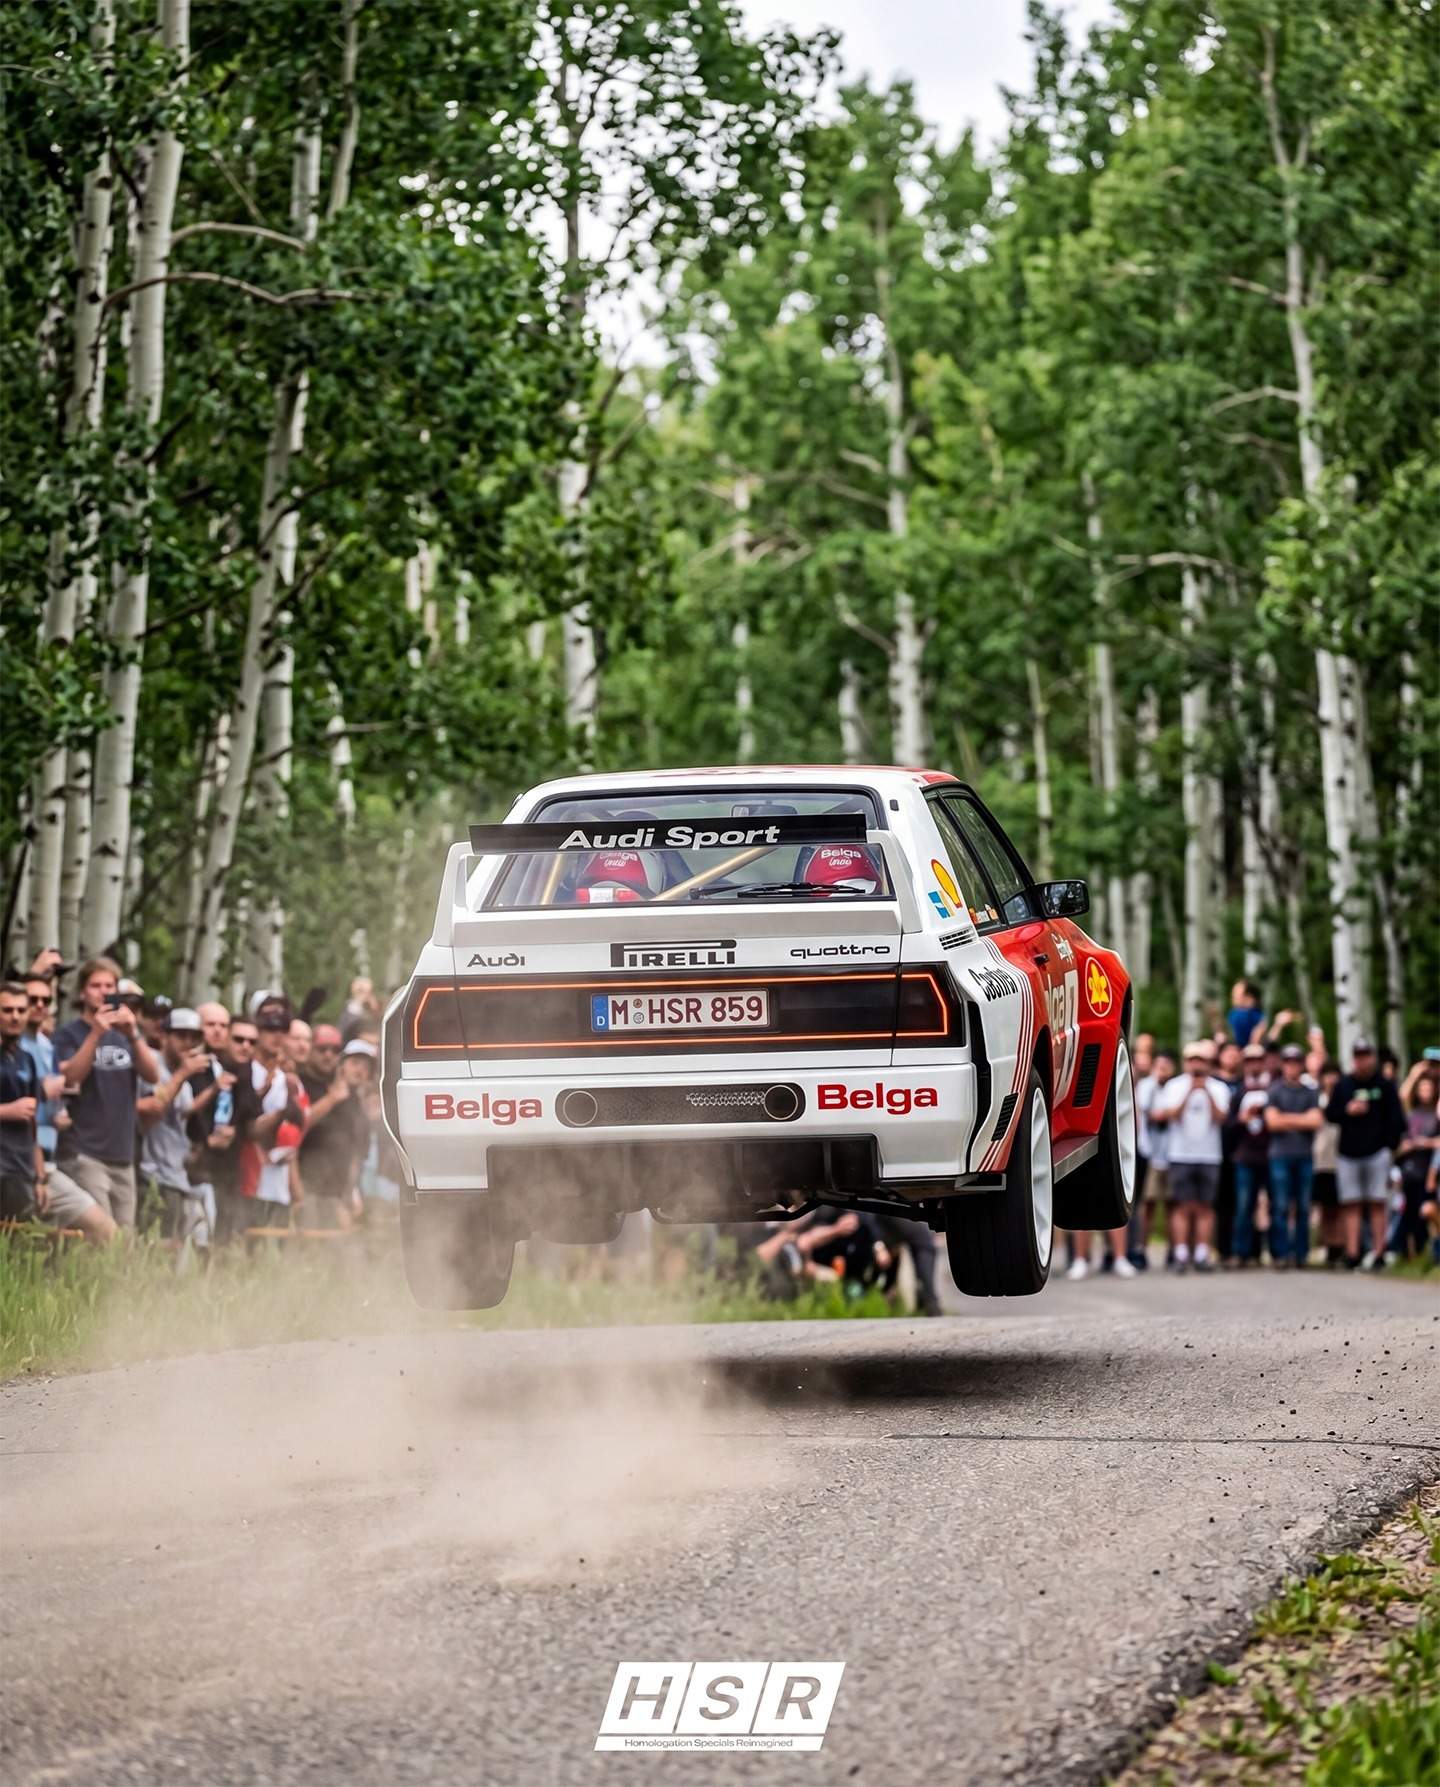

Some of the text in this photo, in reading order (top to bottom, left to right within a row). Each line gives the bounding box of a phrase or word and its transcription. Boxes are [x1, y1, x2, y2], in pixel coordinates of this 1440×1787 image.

[558, 826, 781, 851] Audi Sport
[466, 952, 526, 968] Audi
[610, 939, 737, 968] PIRELLI
[790, 944, 890, 960] quattro
[596, 1015, 606, 1026] D
[611, 995, 763, 1025] M HSR 859
[425, 1093, 543, 1126] Belga
[817, 1082, 938, 1116] Belga
